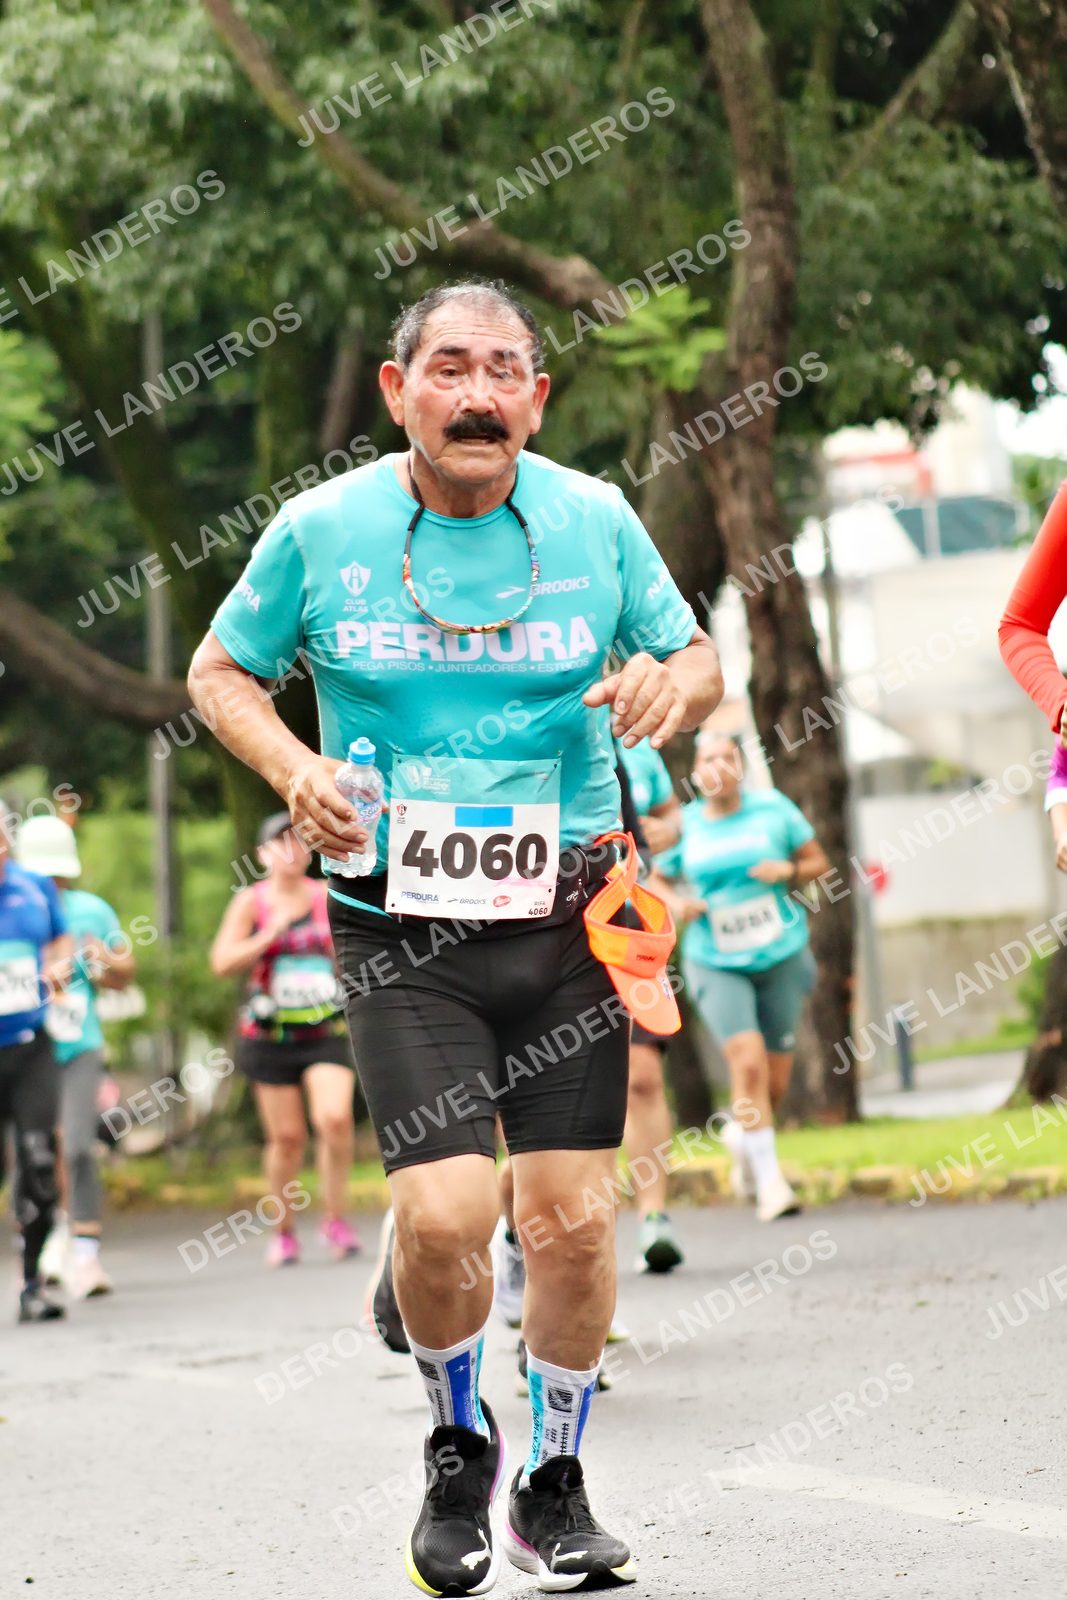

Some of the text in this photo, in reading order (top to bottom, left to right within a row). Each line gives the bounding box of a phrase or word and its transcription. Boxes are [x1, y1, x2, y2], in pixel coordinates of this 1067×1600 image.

[531, 575, 591, 597] BROOKS
[336, 614, 598, 663] PERDURA
[352, 660, 385, 671] PEGA
[388, 661, 425, 673] PISOS
[435, 663, 527, 673] JUNTEADORES
[402, 829, 548, 881] 4060
[401, 890, 439, 902] PERDURA
[528, 907, 548, 916] 4060
